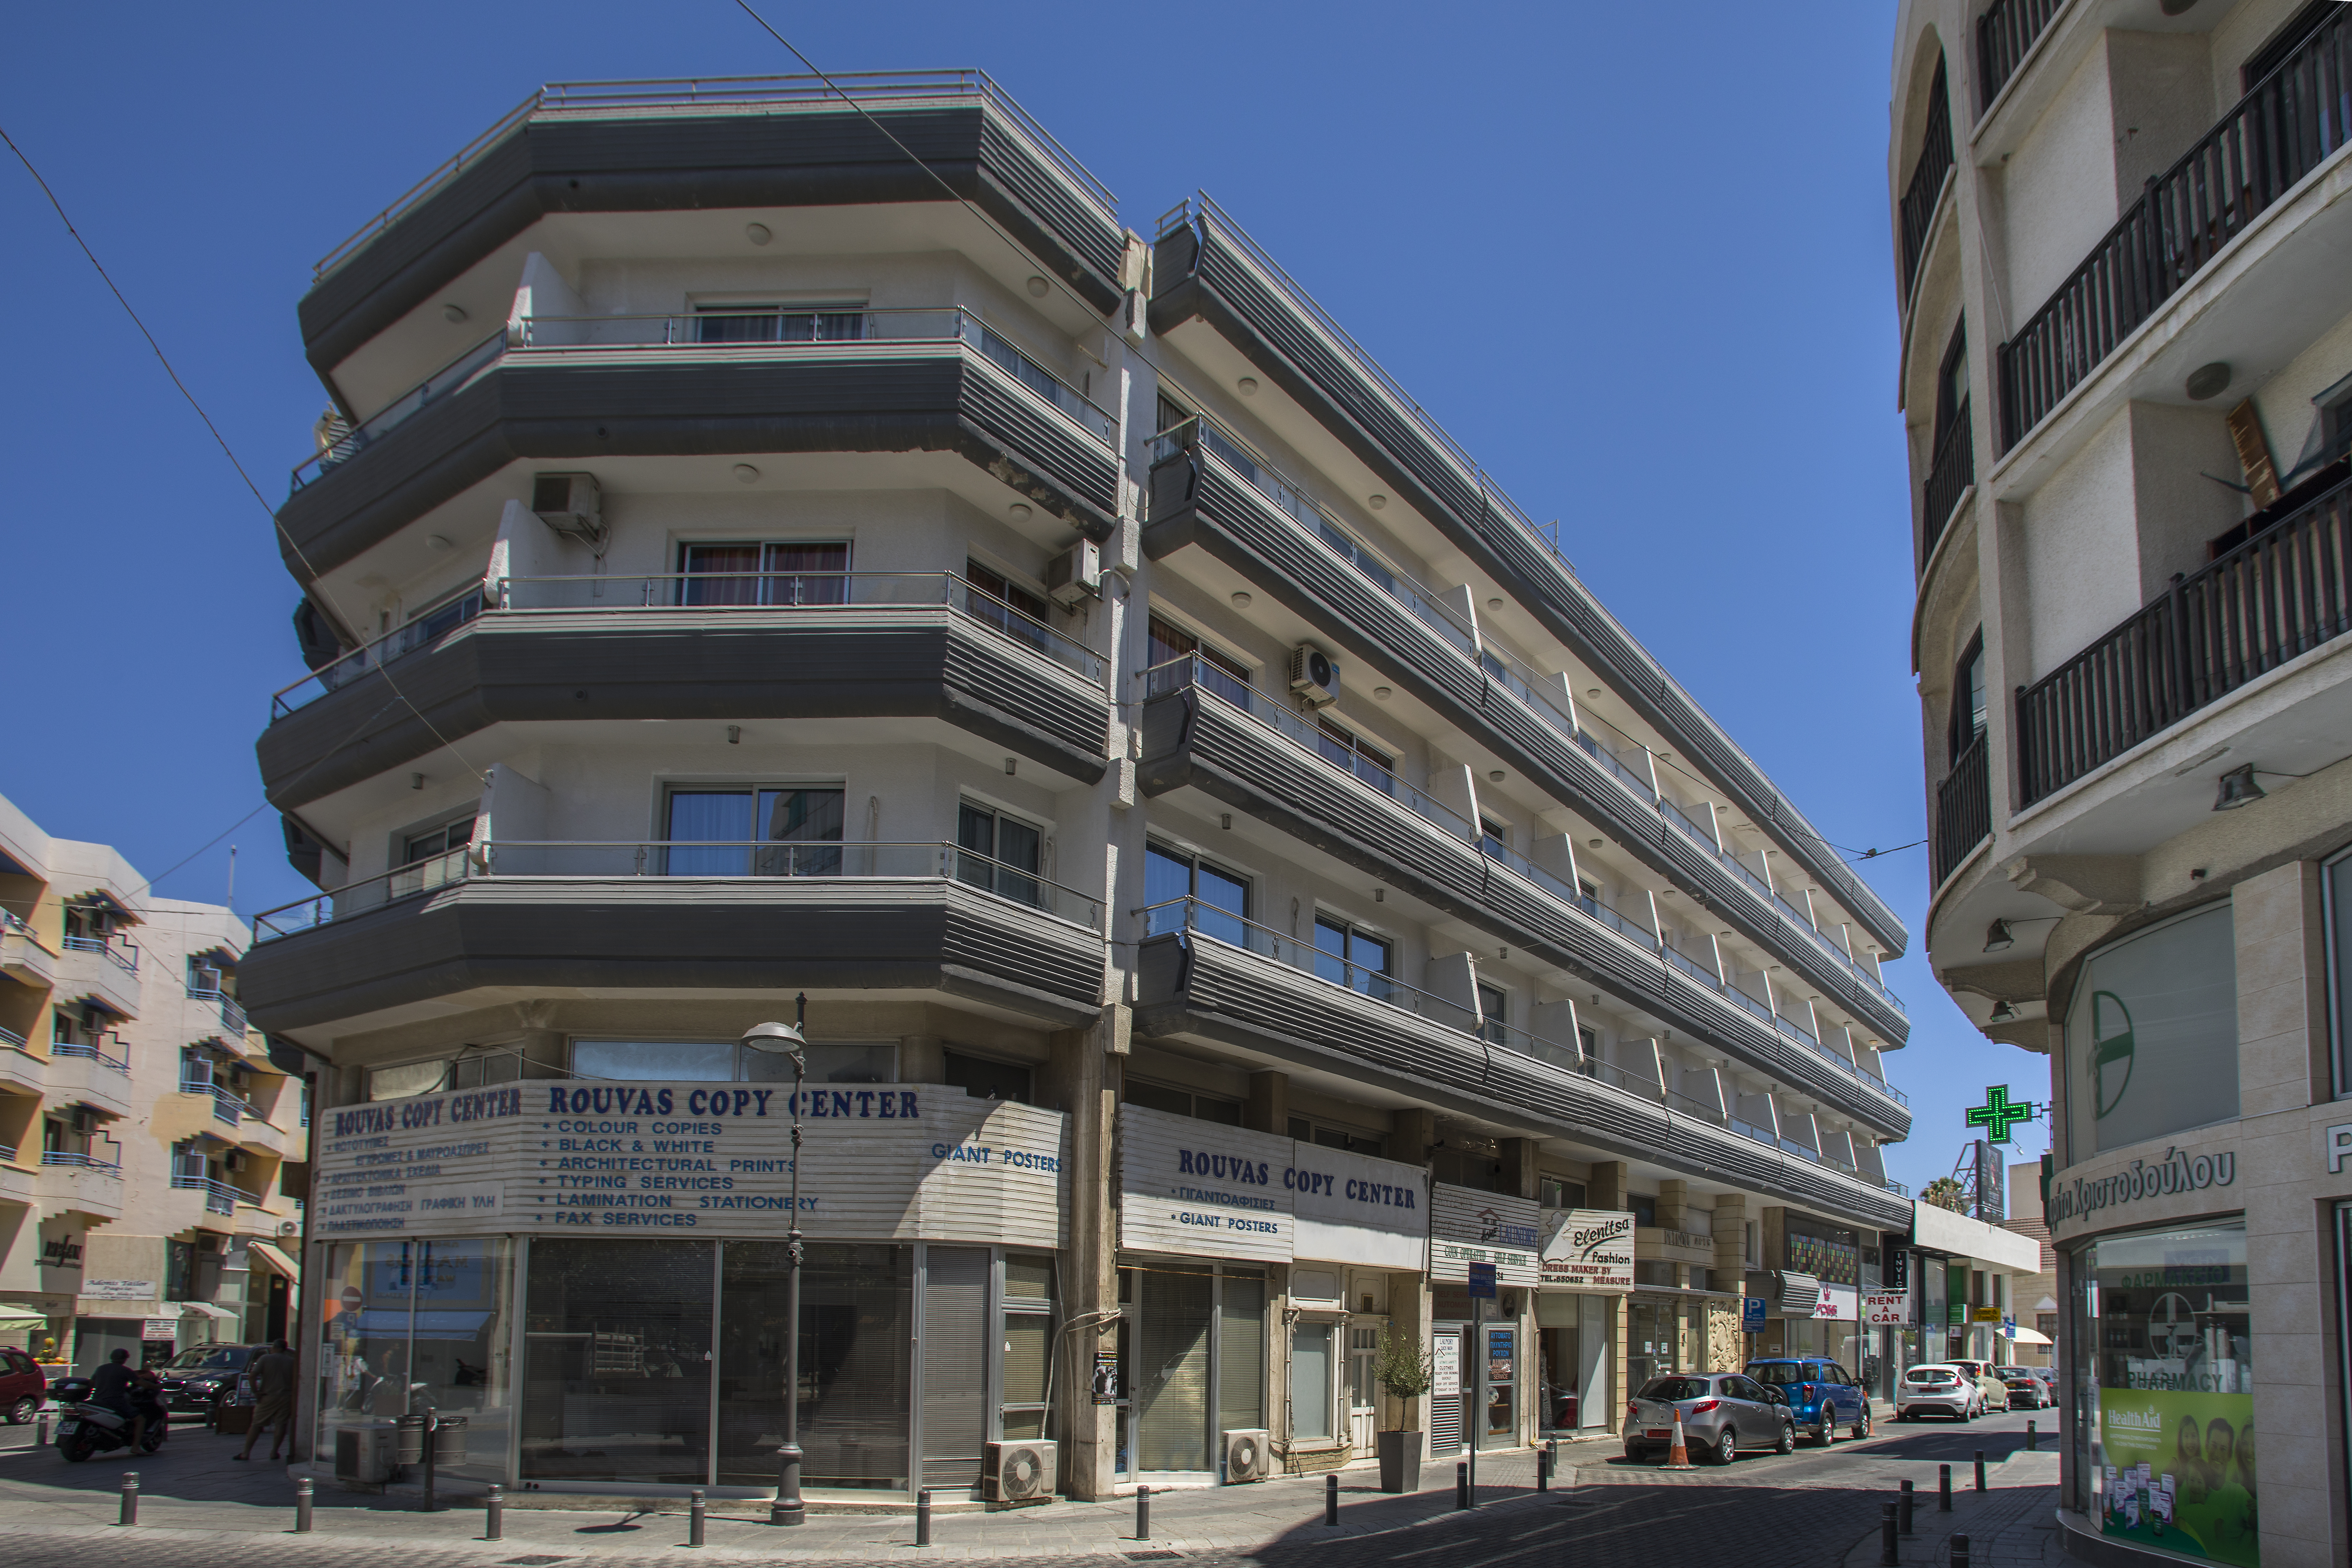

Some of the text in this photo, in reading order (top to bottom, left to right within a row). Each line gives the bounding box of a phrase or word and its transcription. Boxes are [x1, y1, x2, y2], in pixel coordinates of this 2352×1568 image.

[335, 1088, 521, 1136] ROUVAS COPY CENTER
[549, 1087, 920, 1119] ROUVAS COPY CENTER
[558, 1120, 722, 1135] COLOUR COPIES
[417, 1142, 490, 1160] ΜΑΥΡΟΑΣΠΡΕΣ
[559, 1139, 714, 1153] BLACK & WHITE
[558, 1157, 796, 1173] ARCHITECTURAL PRINTS
[932, 1143, 1063, 1173] GIANT POSTERS
[406, 1165, 441, 1177] ΣΧΕΔΙΑ
[1179, 1149, 1269, 1186] ROUVAS
[1284, 1167, 1335, 1197] COPY
[1346, 1178, 1416, 1209] CENTER
[558, 1175, 734, 1189] TYPING SERVICES
[2074, 1147, 2235, 1221] Χριστοδούλου
[329, 1195, 495, 1215] ΔΑΚΤΥΛΟΓΡΑΦΗΣΗ ΓΡΑΦΙΚΗ ΥΛΗ
[557, 1193, 819, 1210] LAMINATION STATIONERY
[1179, 1187, 1276, 1211] ΓΙΓΑΝΤΟΑΦΙΣΙΕΣ
[556, 1212, 697, 1226] FAX SERVICES
[1180, 1212, 1278, 1234] GIANT POSTERS
[1499, 1224, 1538, 1247] LAUNDRY
[1574, 1219, 1629, 1246] Elenitsa
[1445, 1246, 1527, 1265] COIN OPERATED SELF SERVICE
[1542, 1264, 1569, 1272] DRESS
[1571, 1265, 1598, 1274] MAKER
[2121, 1266, 2224, 1289] ΦΑΡΜΑΚΕΙΟ
[1593, 1276, 1630, 1285] MEASURE
[1749, 1299, 1761, 1313] P
[1868, 1296, 1903, 1305] RENT
[2128, 1371, 2223, 1391] PHARMACY
[2108, 1408, 2161, 1429] HealthAid
